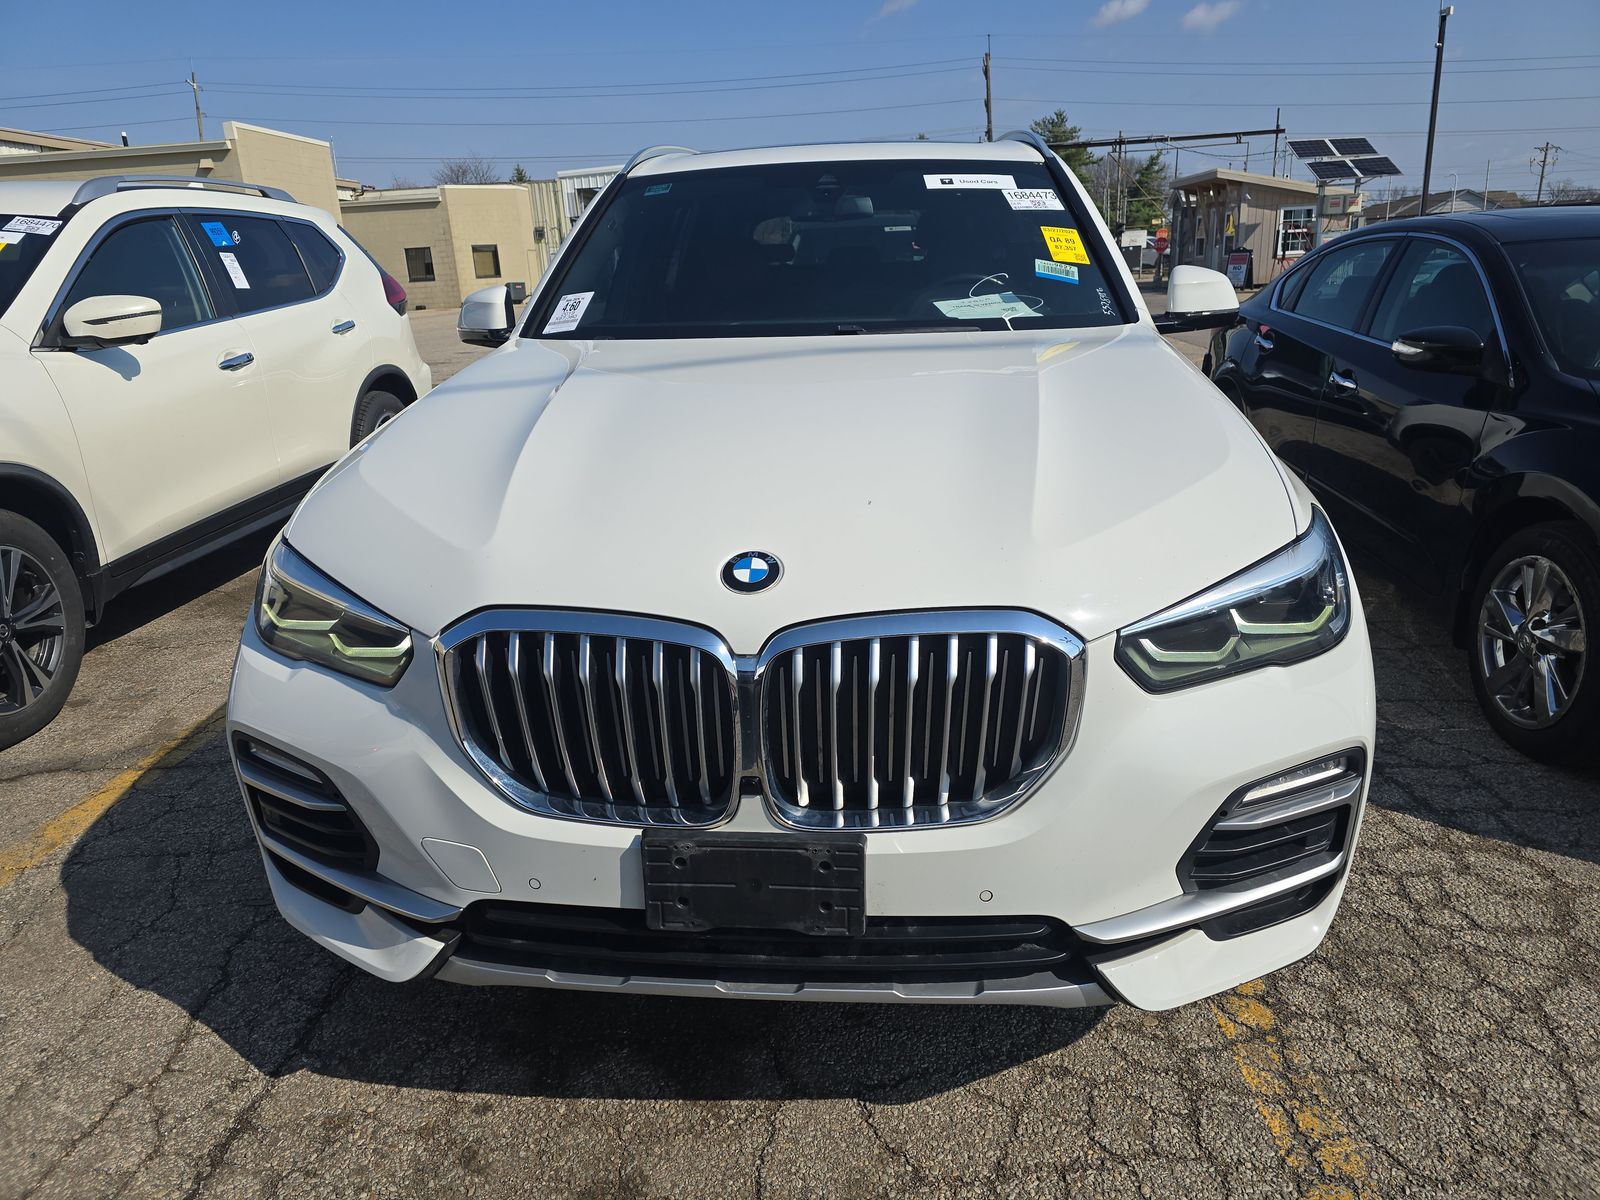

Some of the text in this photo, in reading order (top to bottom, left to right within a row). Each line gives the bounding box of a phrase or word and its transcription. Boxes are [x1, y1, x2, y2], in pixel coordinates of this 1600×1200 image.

[1007, 191, 1058, 200] 1684473
[1154, 241, 1168, 249] STOP
[562, 300, 582, 311] 4:60
